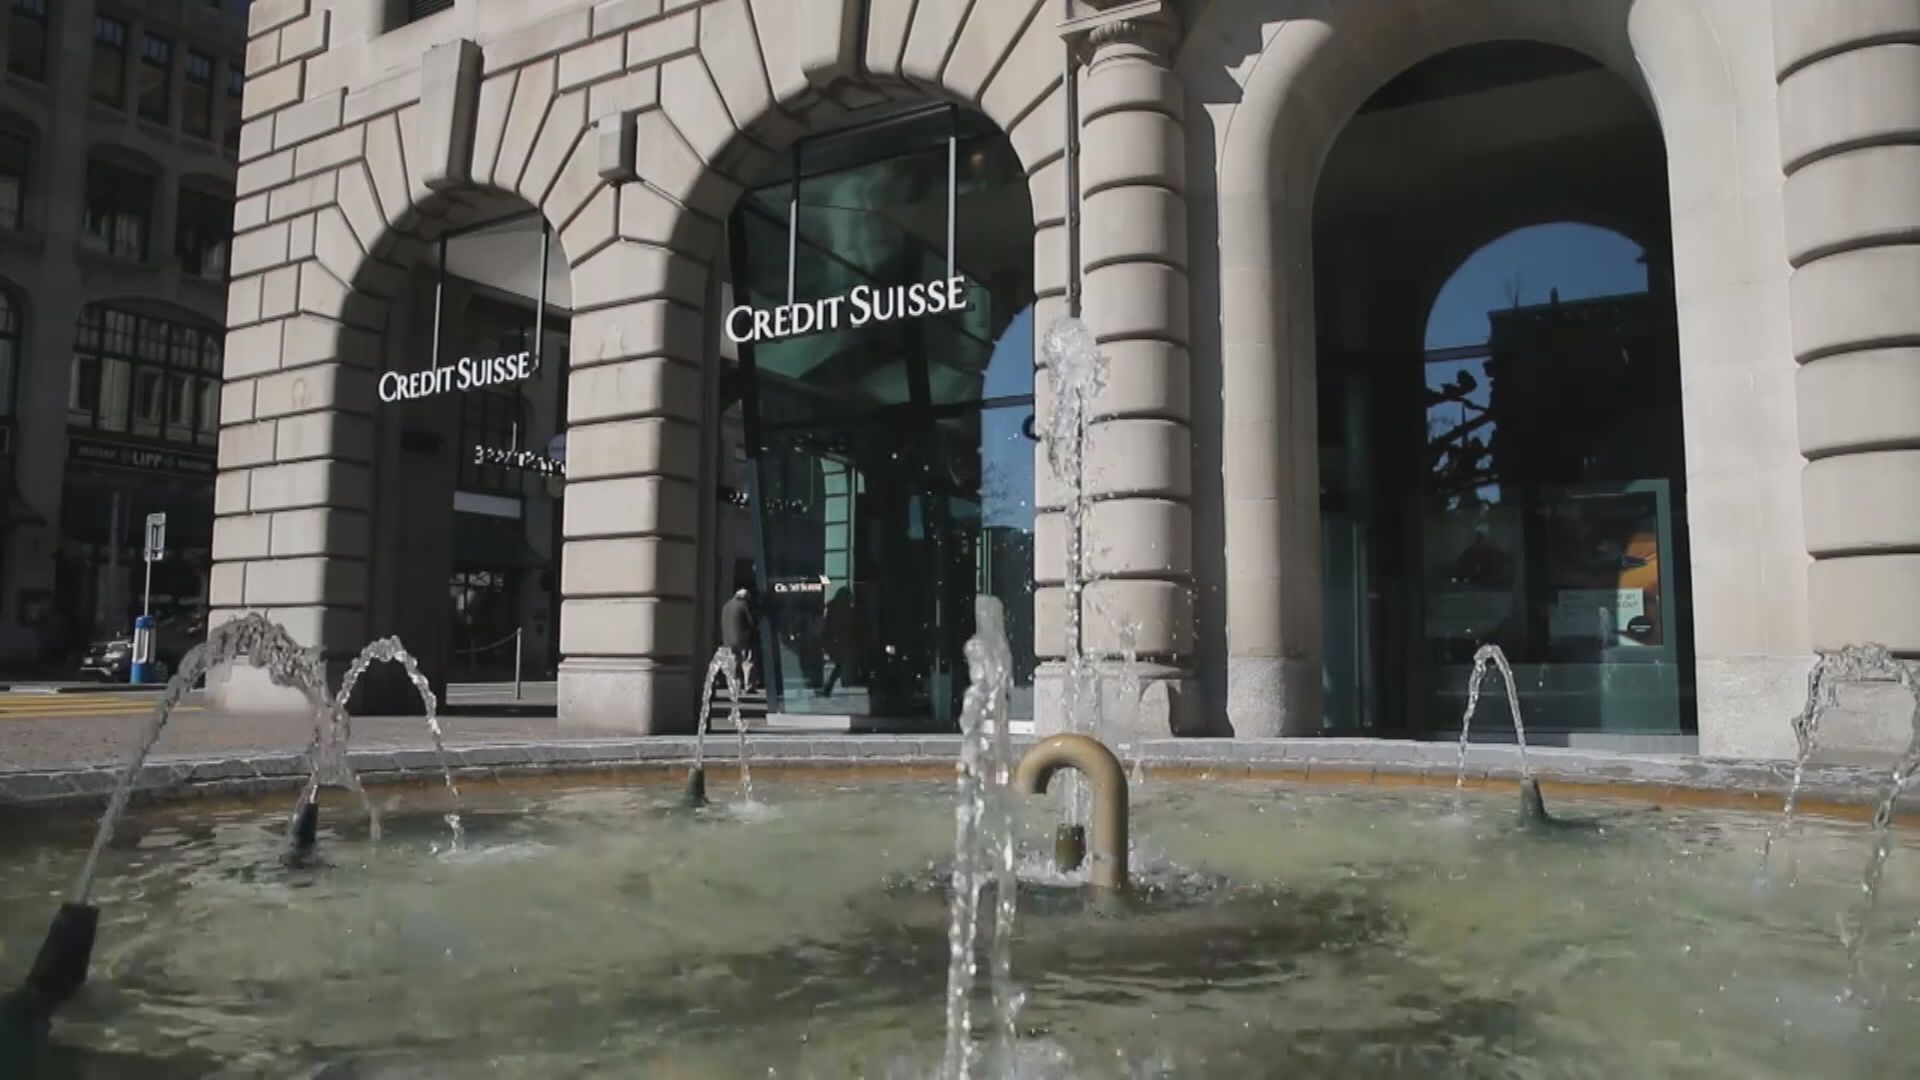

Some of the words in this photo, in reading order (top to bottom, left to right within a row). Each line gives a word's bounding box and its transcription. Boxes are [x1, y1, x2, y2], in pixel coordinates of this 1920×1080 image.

[725, 295, 845, 342] CREDIT
[849, 276, 967, 325] SUISSE
[378, 366, 455, 402] CREDIT
[456, 351, 530, 391] SUISSE
